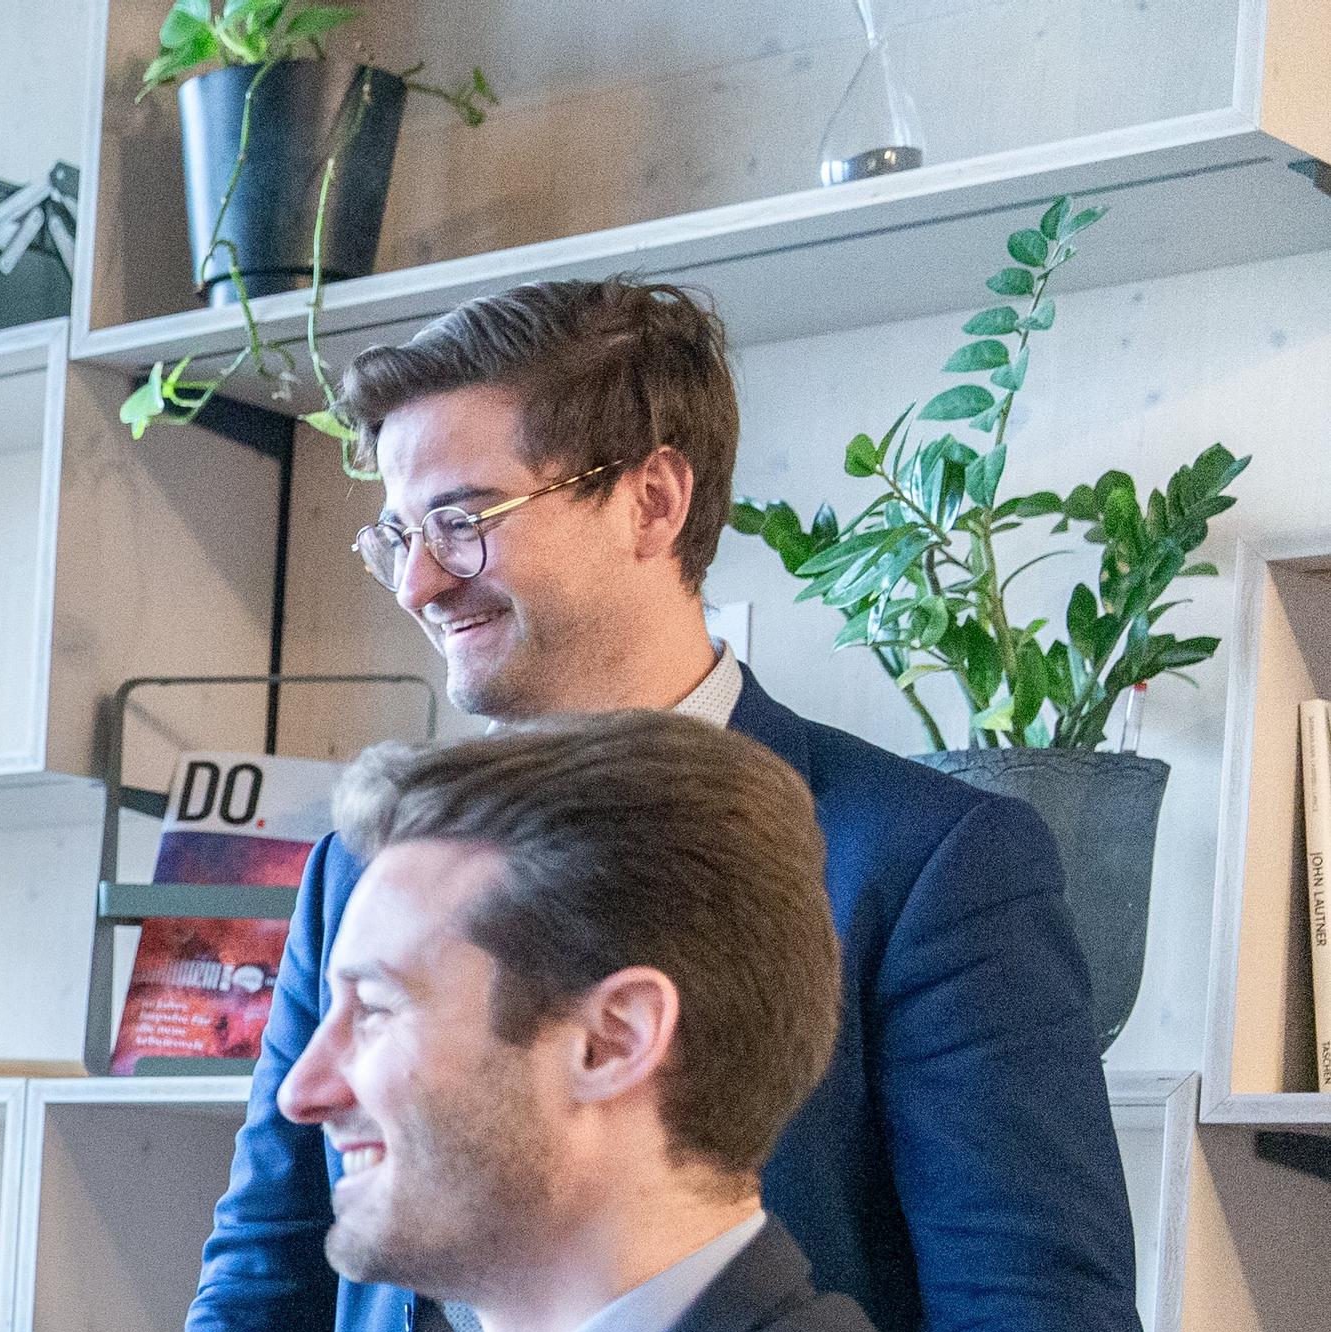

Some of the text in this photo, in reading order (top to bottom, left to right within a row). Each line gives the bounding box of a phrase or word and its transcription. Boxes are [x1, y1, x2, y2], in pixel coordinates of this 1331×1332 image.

[1310, 852, 1327, 947] JOHN LAUTNER
[1321, 1040, 1331, 1085] TASCHEN
